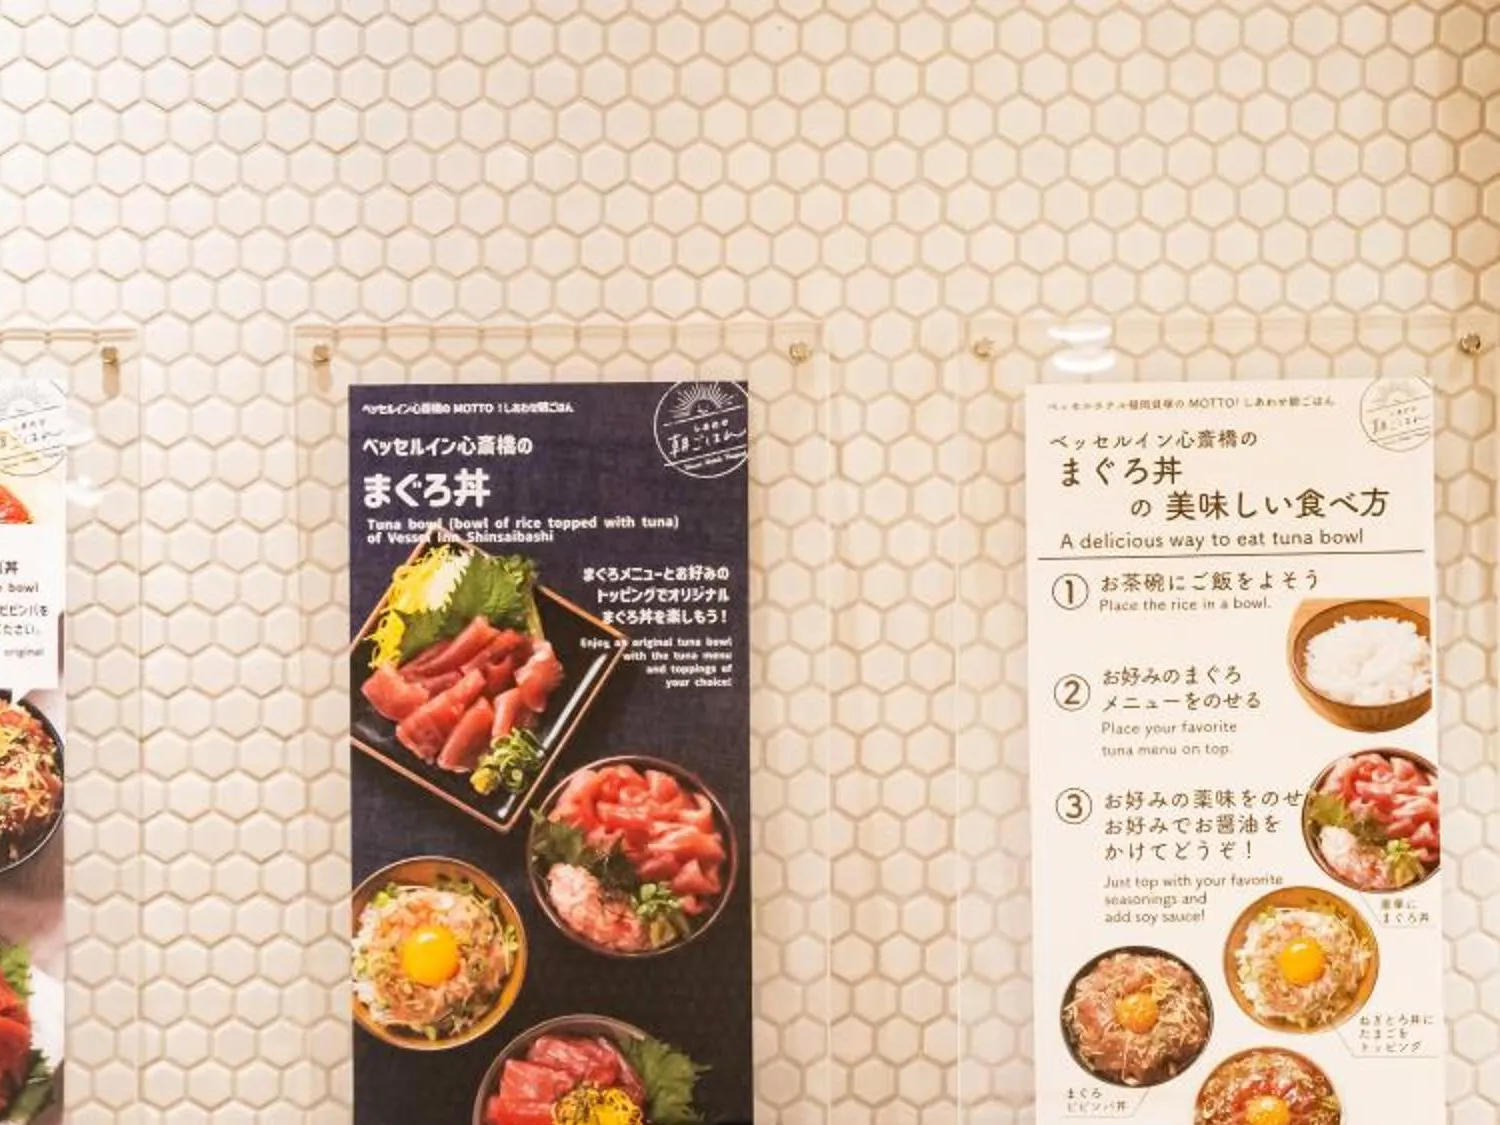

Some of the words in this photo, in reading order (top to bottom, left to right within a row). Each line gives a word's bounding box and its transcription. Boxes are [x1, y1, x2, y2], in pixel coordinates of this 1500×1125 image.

[363, 434, 533, 456] ベッセルイン心斎橋の
[1050, 429, 1257, 450] ベッセルイン心斎橋の
[1061, 455, 1183, 487] まぐろ丼
[363, 467, 491, 509] まぐろ丼
[367, 518, 401, 531] Tuna
[408, 517, 443, 530] bowl
[495, 516, 510, 529] of
[515, 516, 542, 529] rice
[548, 515, 597, 531] topped
[604, 515, 635, 529] with
[367, 531, 382, 544] of
[468, 531, 554, 543] Shinsaibashi
[1060, 533, 1074, 549] A
[1079, 532, 1164, 549] delicious
[1169, 535, 1204, 551] way
[1212, 534, 1230, 546] to
[1237, 533, 1265, 546] eat
[1273, 531, 1313, 545] tuna
[1320, 528, 1363, 544] bowl
[583, 566, 730, 582] まぐろメニューとお好みの
[1100, 569, 1319, 592] お茶碗にご飯をよそう
[8, 583, 40, 594] bowl
[597, 588, 730, 604] トッピングでオリジナル
[1100, 598, 1138, 611] Place
[1143, 598, 1165, 610] the
[1171, 598, 1197, 610] rice
[1203, 598, 1215, 609] in
[580, 637, 610, 650] Enjoy
[632, 637, 672, 650] original
[676, 638, 701, 648] tuna
[706, 637, 732, 648] bowl
[623, 651, 647, 661] with
[651, 651, 669, 661] the
[646, 664, 666, 674] and
[671, 664, 717, 676] toppings
[1102, 666, 1241, 687] お好みのまぐろ
[665, 679, 689, 689] your
[1102, 691, 1261, 713] メニューをのせる
[1101, 721, 1140, 735] Place
[1144, 722, 1176, 737] your
[1182, 720, 1237, 733] favorite
[1102, 745, 1133, 757] tuna
[1138, 745, 1177, 756] menu
[1182, 745, 1201, 755] on
[1105, 813, 1281, 836] お好みでお醤油を
[1103, 875, 1132, 888] Just
[1135, 875, 1159, 890] top
[1163, 875, 1191, 887] with
[1195, 876, 1226, 889] your
[1231, 873, 1284, 886] favorite
[1105, 894, 1177, 909] seasonings
[1182, 893, 1207, 905] and
[1105, 911, 1131, 923] add
[1135, 912, 1158, 926] soy
